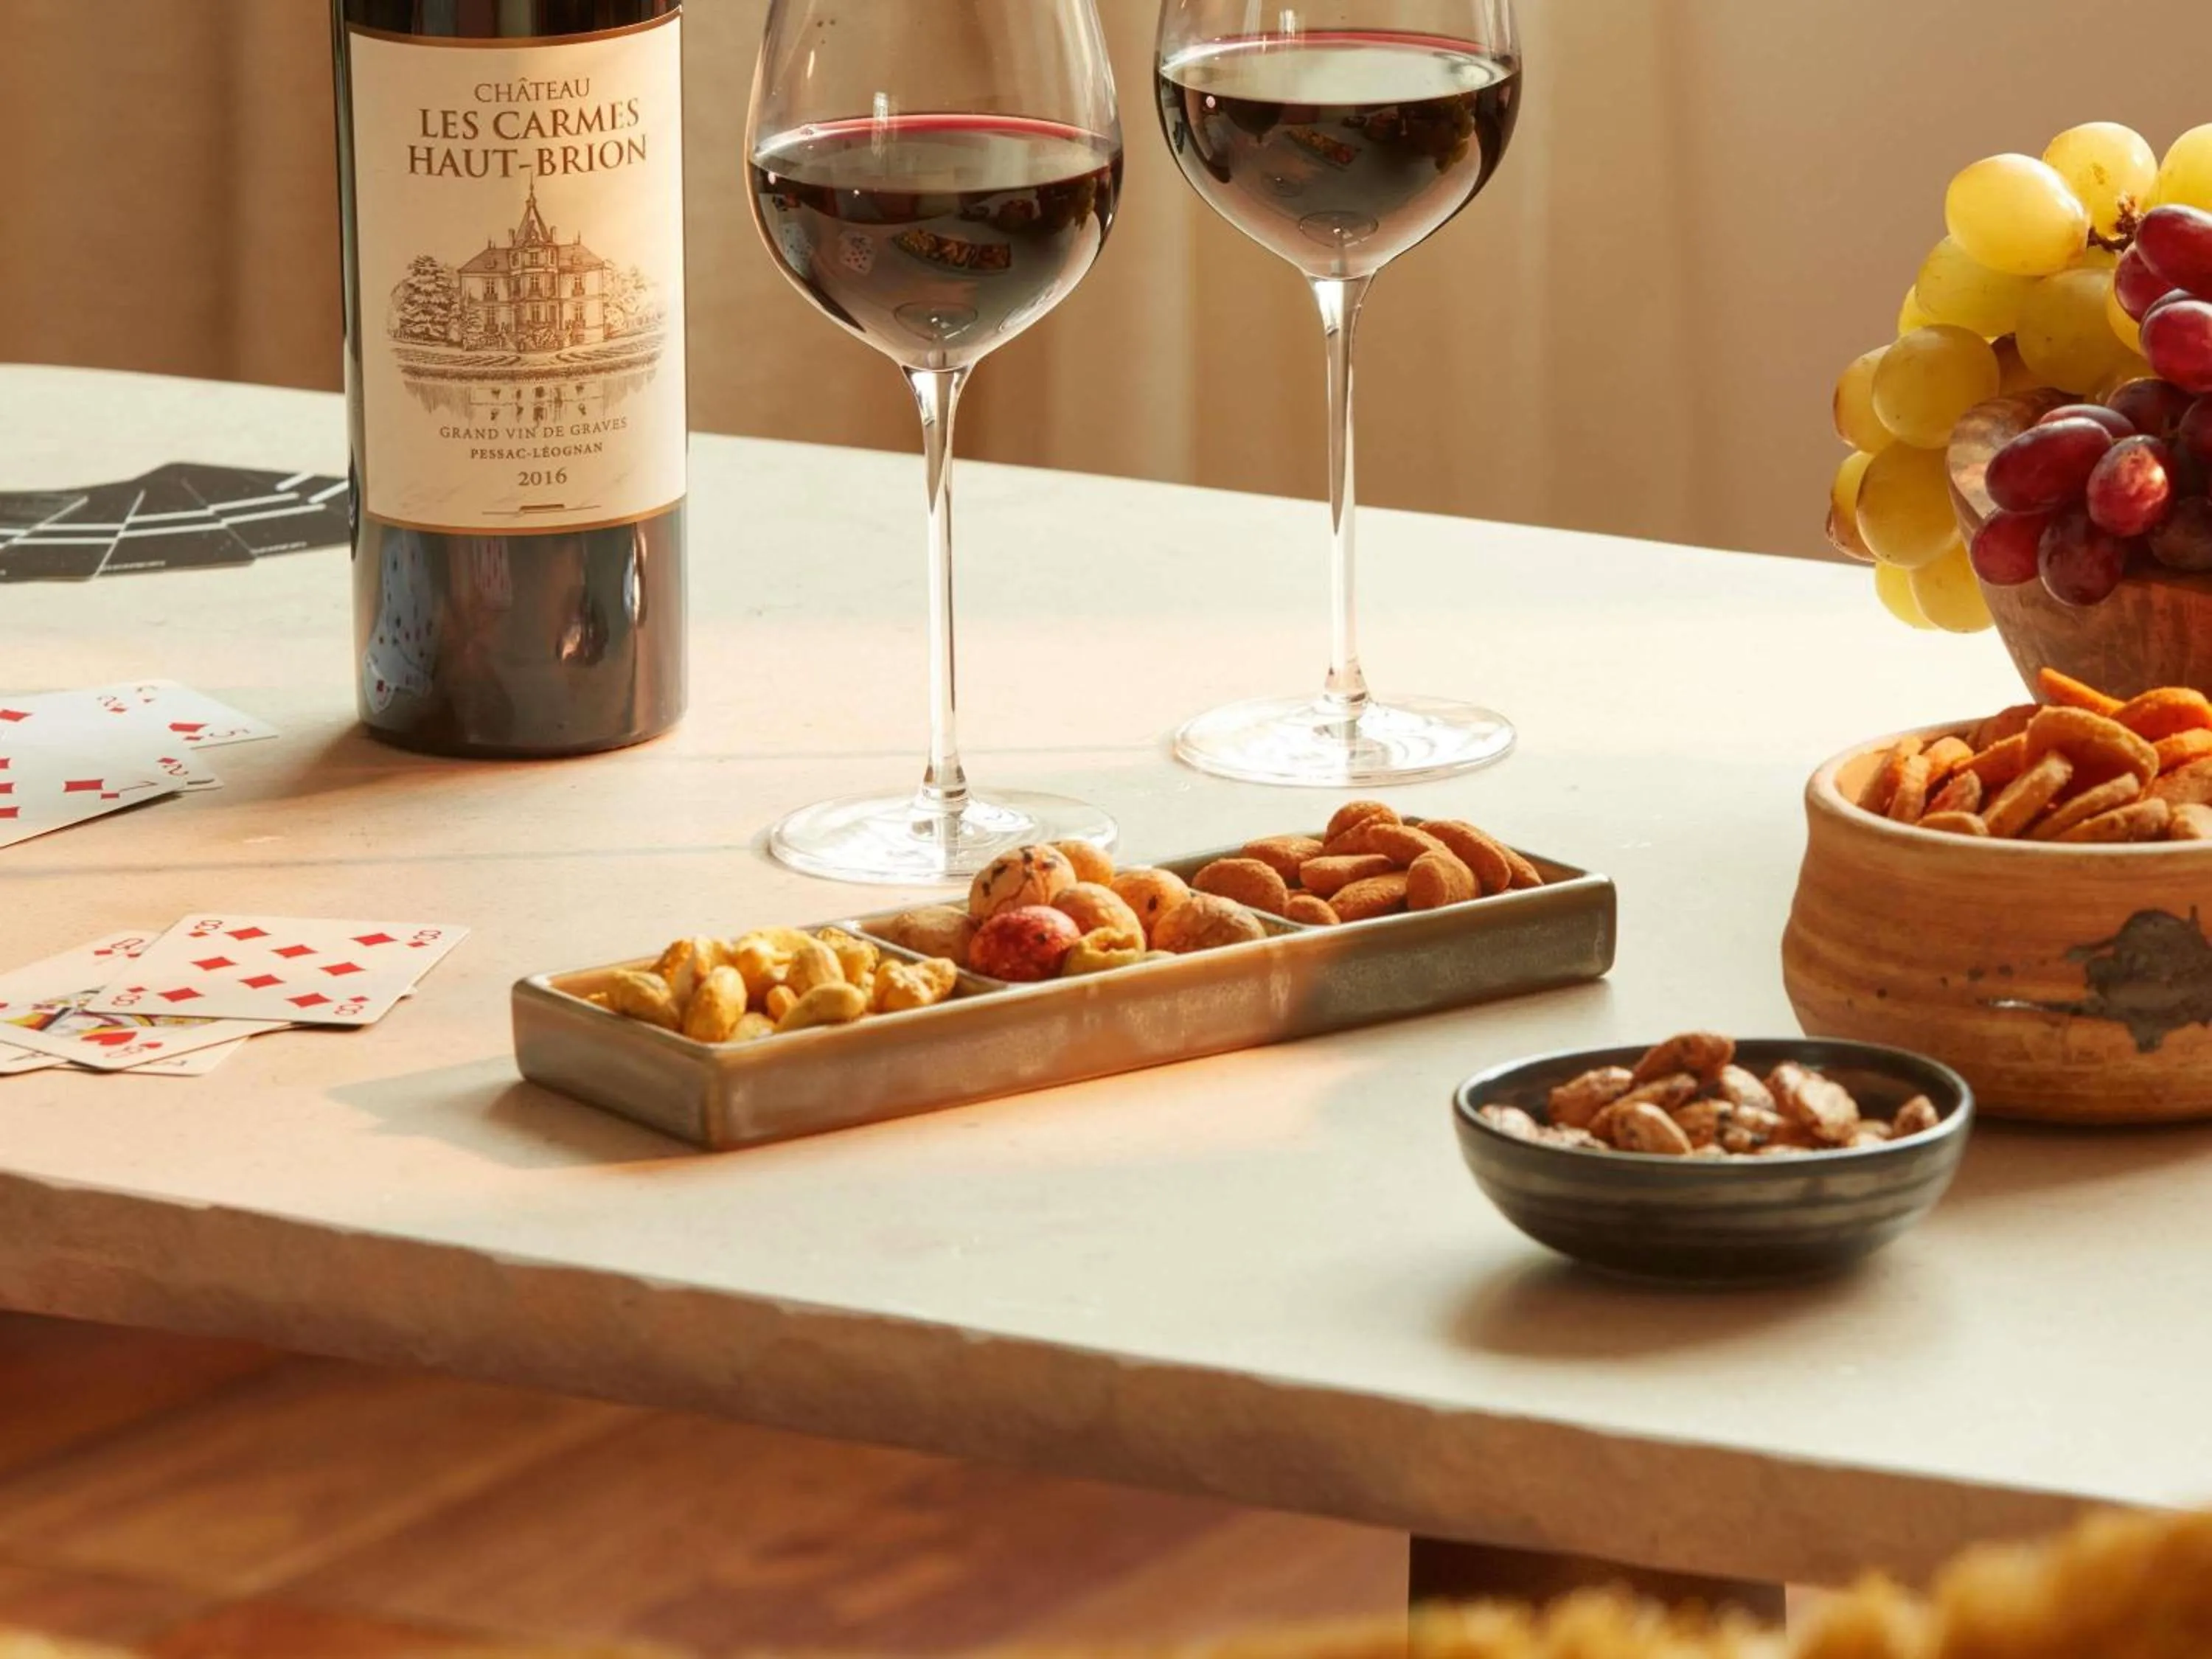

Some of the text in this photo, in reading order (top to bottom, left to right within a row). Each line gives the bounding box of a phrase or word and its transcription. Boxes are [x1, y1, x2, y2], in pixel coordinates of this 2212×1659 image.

[474, 77, 590, 103] CHÂTEAU
[419, 97, 639, 141] LES CARMES
[408, 133, 647, 178] HAUT-BRION
[439, 417, 628, 440] GRAND VIN DE GRAVES
[470, 442, 604, 459] PESSAC-LÉOGNAN
[518, 467, 568, 487] 2016
[194, 919, 223, 931] 8
[413, 929, 442, 941] 8
[111, 994, 142, 1006] 8
[333, 1004, 364, 1016] 8
